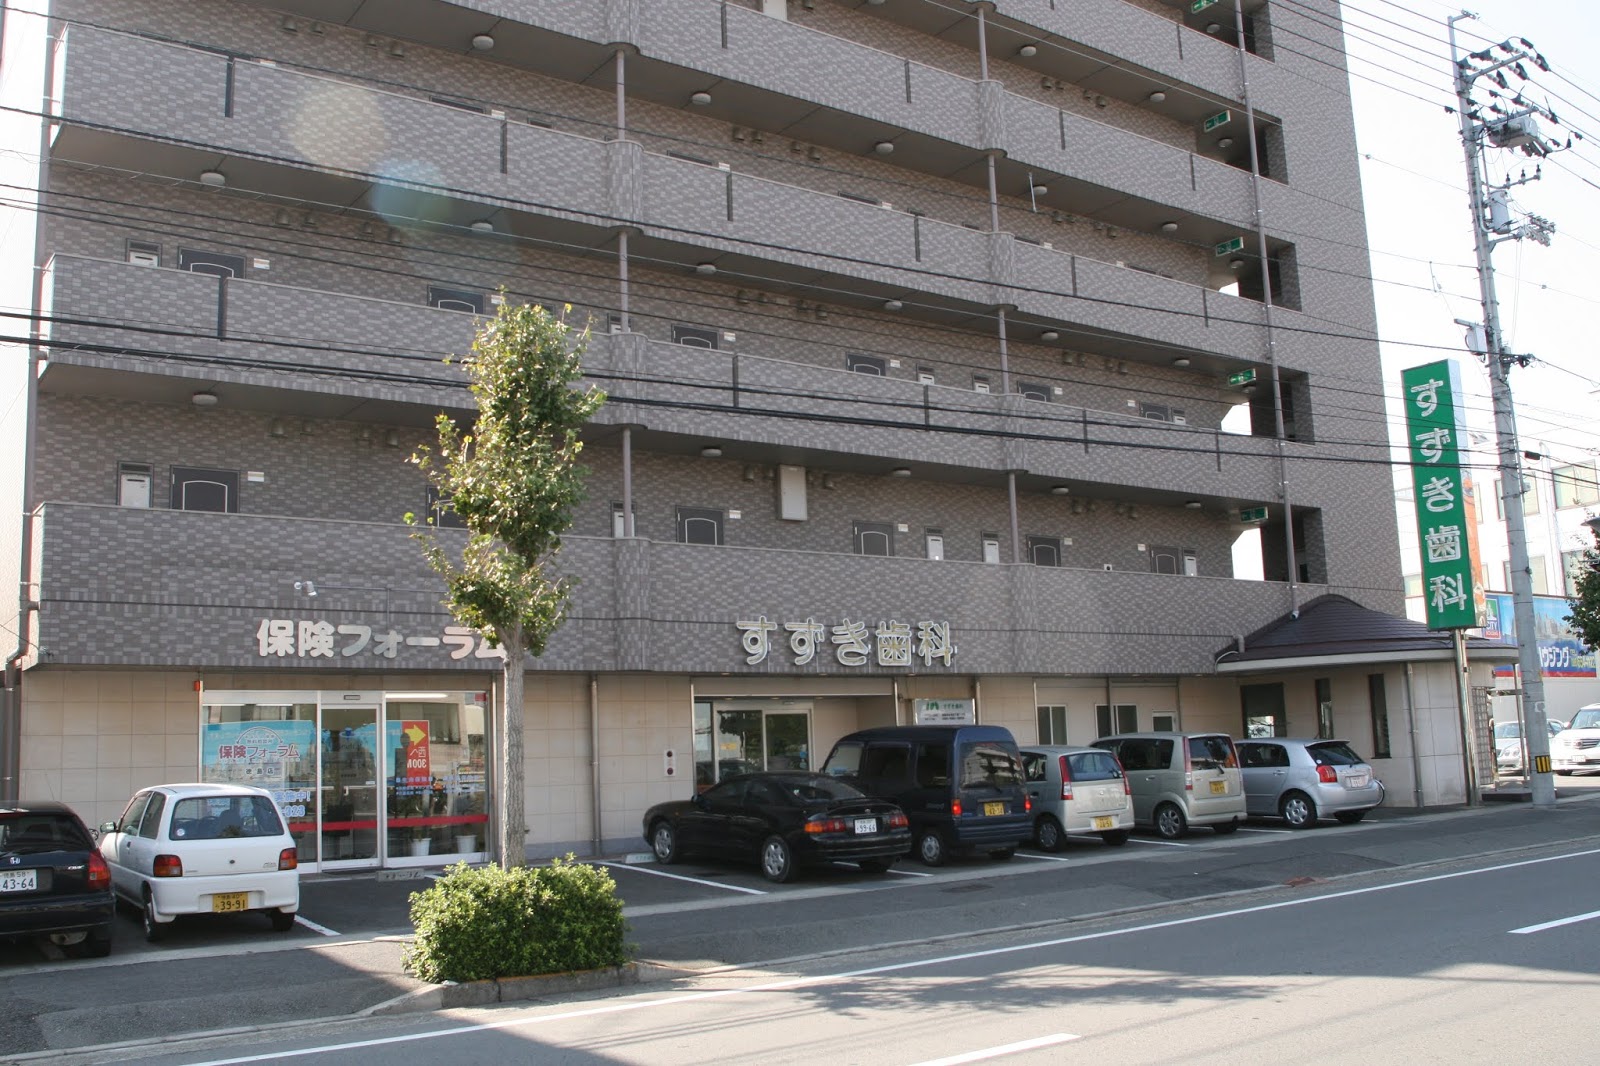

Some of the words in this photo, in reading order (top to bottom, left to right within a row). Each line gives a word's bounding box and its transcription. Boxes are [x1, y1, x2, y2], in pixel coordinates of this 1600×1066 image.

[1410, 378, 1467, 613] すずき歯科
[256, 618, 507, 660] 保険フォーラム
[736, 615, 954, 667] すずき歯科
[219, 744, 300, 759] 保険フォーラム
[2, 877, 34, 890] 43-64
[220, 899, 246, 911] 39-91
